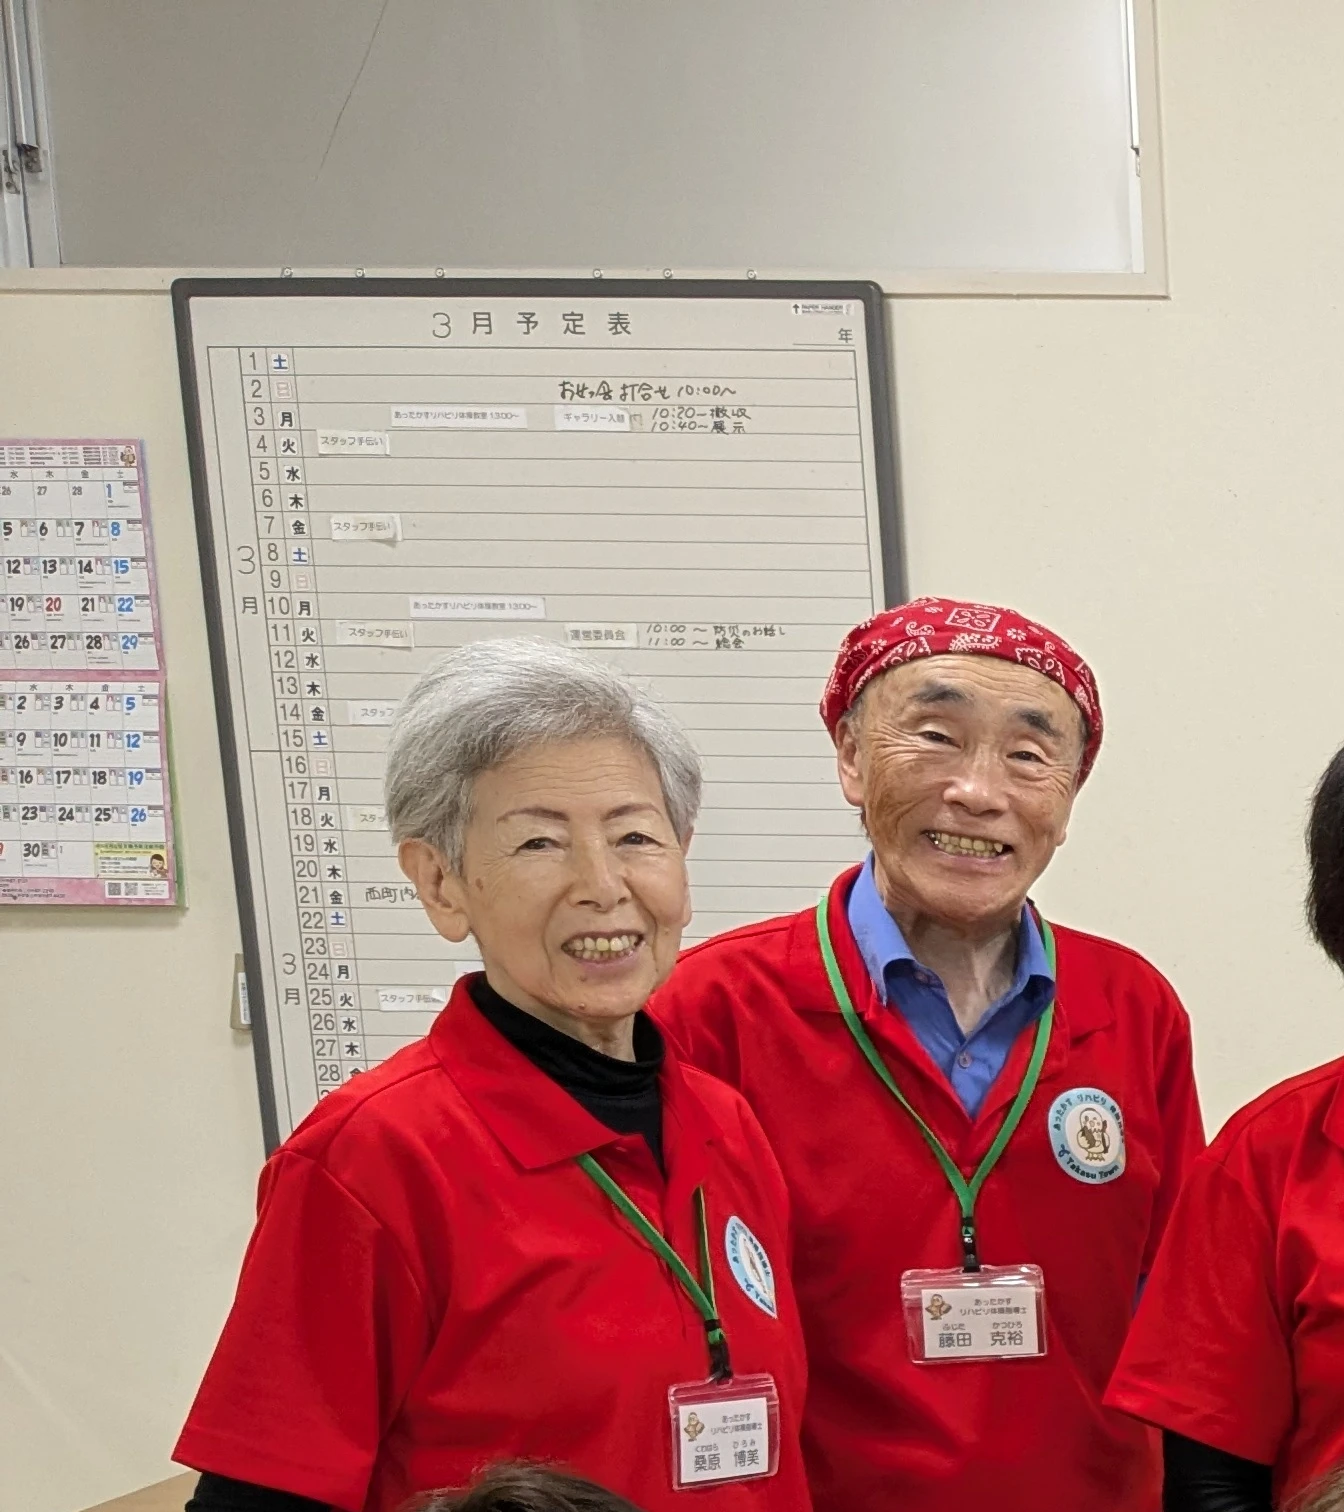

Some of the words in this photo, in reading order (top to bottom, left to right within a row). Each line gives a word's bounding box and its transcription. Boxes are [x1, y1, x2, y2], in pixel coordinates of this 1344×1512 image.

[838, 328, 853, 343] 年
[250, 352, 256, 370] 1
[273, 355, 288, 369] 土
[251, 380, 262, 398] 2
[254, 407, 264, 425] 3
[280, 412, 293, 427] 月
[257, 435, 267, 452] 4
[282, 438, 296, 453] 火
[259, 462, 270, 480] 5
[286, 467, 300, 481] 水
[1, 486, 11, 495] 26
[37, 486, 47, 495] 27
[72, 486, 83, 496] 28
[106, 484, 112, 498] 1
[262, 489, 273, 507] 6
[289, 494, 303, 509] 木
[3, 522, 12, 536] 5
[39, 522, 48, 536] 6
[74, 522, 84, 536] 7
[111, 522, 120, 536] 8
[264, 516, 274, 534] 7
[292, 520, 306, 535] 金
[268, 543, 278, 562] 8
[293, 548, 307, 563] 土
[6, 559, 21, 574] 12
[42, 559, 57, 574] 13
[78, 559, 93, 574] 14
[114, 560, 129, 574] 15
[270, 570, 280, 588] 9
[10, 597, 24, 612] 19
[46, 597, 61, 612] 20
[81, 597, 95, 612] 21
[118, 597, 133, 612] 22
[268, 596, 290, 615] 10
[298, 601, 311, 616] 月
[14, 635, 30, 649] 26
[50, 635, 66, 649] 27
[86, 635, 102, 650] 28
[122, 635, 138, 649] 29
[271, 624, 290, 642] 11
[302, 628, 316, 643] 火
[274, 650, 295, 668] 12
[305, 653, 319, 668] 水
[277, 677, 298, 695] 13
[307, 682, 320, 696] 木
[17, 695, 27, 710] 2
[54, 696, 64, 710] 3
[89, 696, 100, 710] 4
[125, 697, 136, 711] 5
[280, 703, 301, 720] 14
[311, 707, 325, 721] 金
[17, 732, 27, 747] 9
[53, 732, 68, 747] 10
[90, 733, 101, 748] 11
[126, 733, 141, 748] 12
[282, 730, 304, 747] 15
[313, 732, 328, 746] 土
[285, 756, 306, 774] 16
[19, 770, 33, 784] 16
[55, 770, 71, 784] 17
[92, 770, 107, 785] 18
[128, 770, 144, 785] 19
[288, 782, 308, 799] 17
[318, 786, 330, 801] 月
[22, 806, 38, 821] 23
[58, 807, 74, 821] 24
[94, 807, 111, 821] 25
[131, 808, 147, 822] 26
[291, 808, 312, 826] 18
[320, 813, 334, 828] 火
[23, 843, 41, 857] 30
[294, 834, 314, 852] 19
[324, 839, 338, 853] 水
[296, 860, 318, 878] 20
[327, 865, 341, 879] 木
[299, 886, 319, 904] 21
[329, 891, 343, 905] 金
[302, 912, 324, 929] 22
[330, 912, 345, 926] 土
[304, 937, 327, 955] 23
[307, 963, 330, 980] 24
[337, 965, 349, 979] 月
[310, 989, 332, 1006] 25
[339, 994, 353, 1008] 火
[312, 1014, 335, 1031] 26
[342, 1017, 356, 1032] 水
[315, 1039, 337, 1056] 27
[345, 1042, 360, 1056] 木
[318, 1065, 340, 1082] 28
[938, 1333, 972, 1348] 藤田
[990, 1331, 1023, 1346] 克裕
[734, 1449, 759, 1467] 博美
